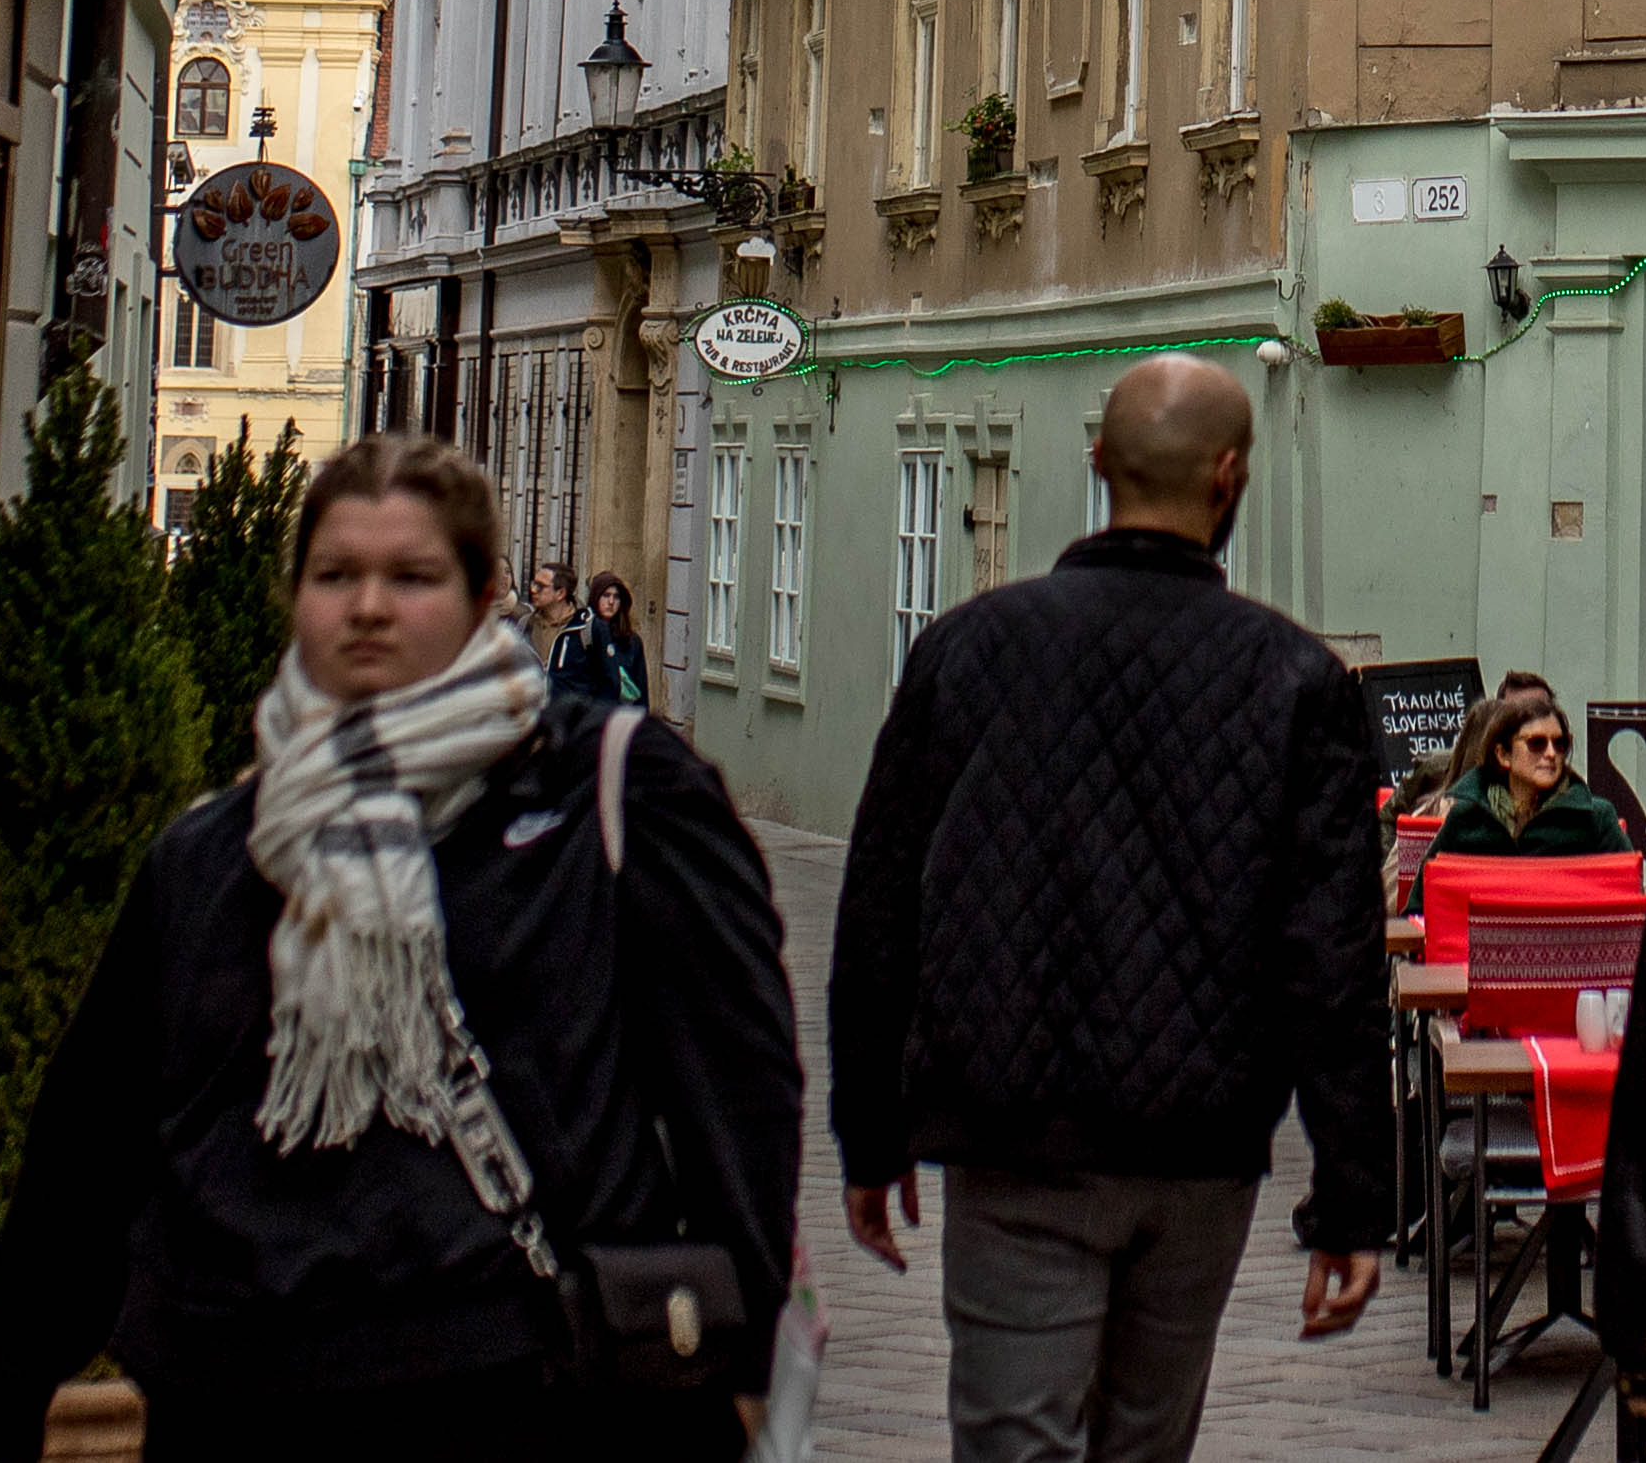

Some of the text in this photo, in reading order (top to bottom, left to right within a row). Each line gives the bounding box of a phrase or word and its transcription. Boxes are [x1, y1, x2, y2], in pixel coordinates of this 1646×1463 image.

[221, 238, 293, 264] Green
[197, 263, 310, 291] BUDDHA
[722, 306, 779, 330] KRČMA
[701, 338, 721, 361] PUB
[731, 338, 797, 373] RESTAURANT
[1382, 684, 1466, 712] TRADIČNÉ
[1382, 709, 1466, 734] SLOVENSKÉ
